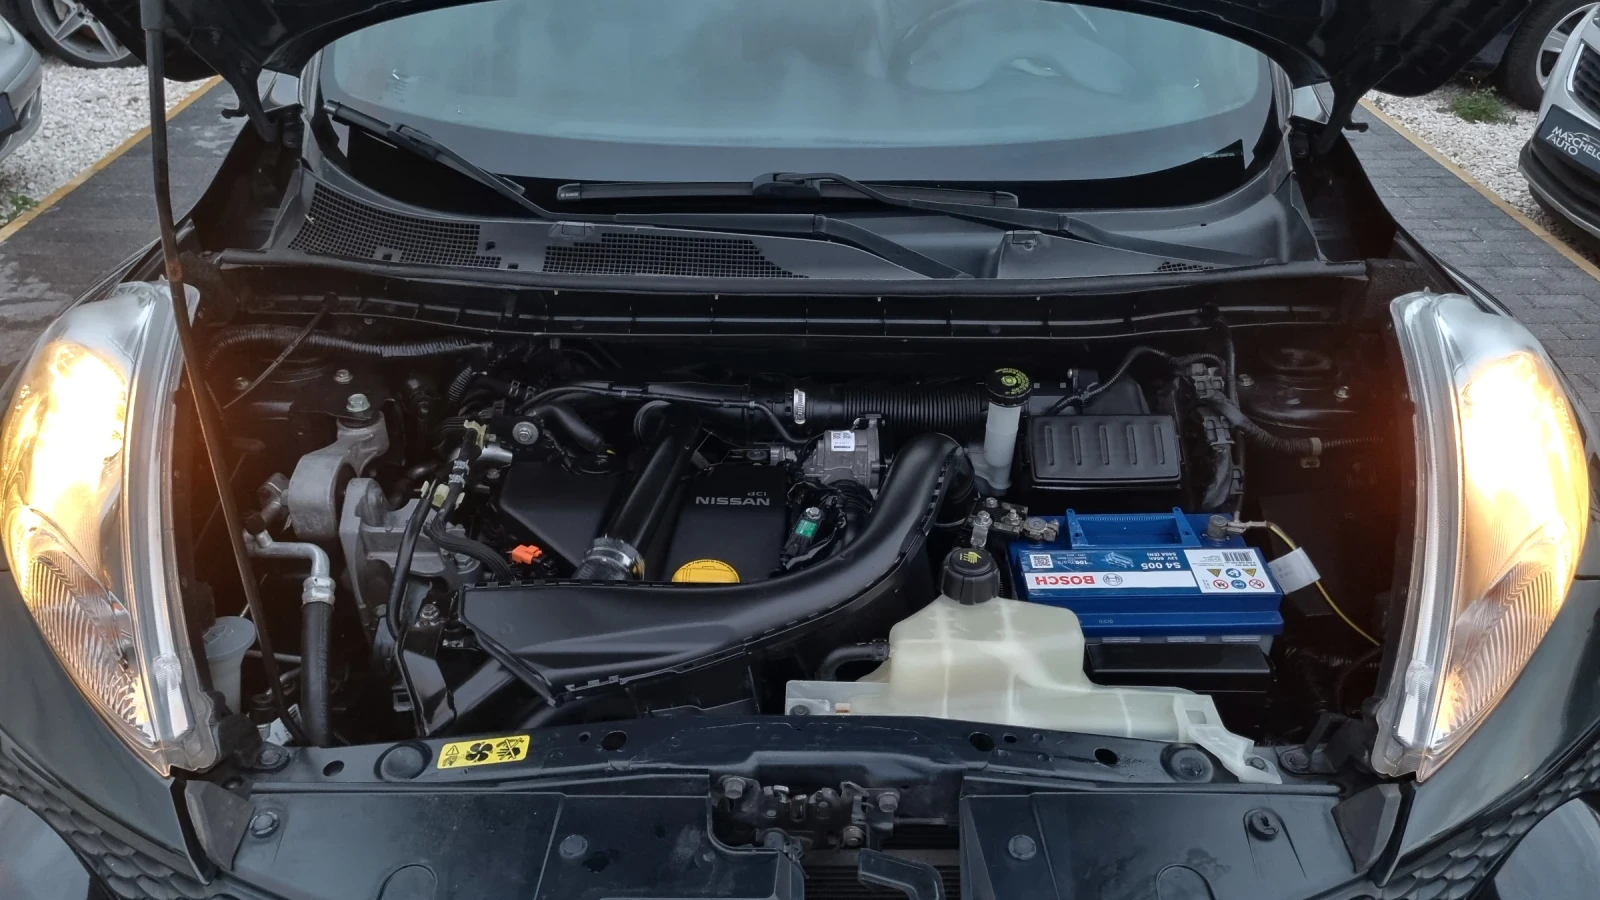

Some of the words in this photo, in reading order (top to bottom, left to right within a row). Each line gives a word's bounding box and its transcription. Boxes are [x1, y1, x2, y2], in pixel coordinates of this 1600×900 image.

[1546, 133, 1578, 155] AUTO
[695, 496, 770, 506] NISSAN
[1035, 575, 1095, 586] BOSCH
